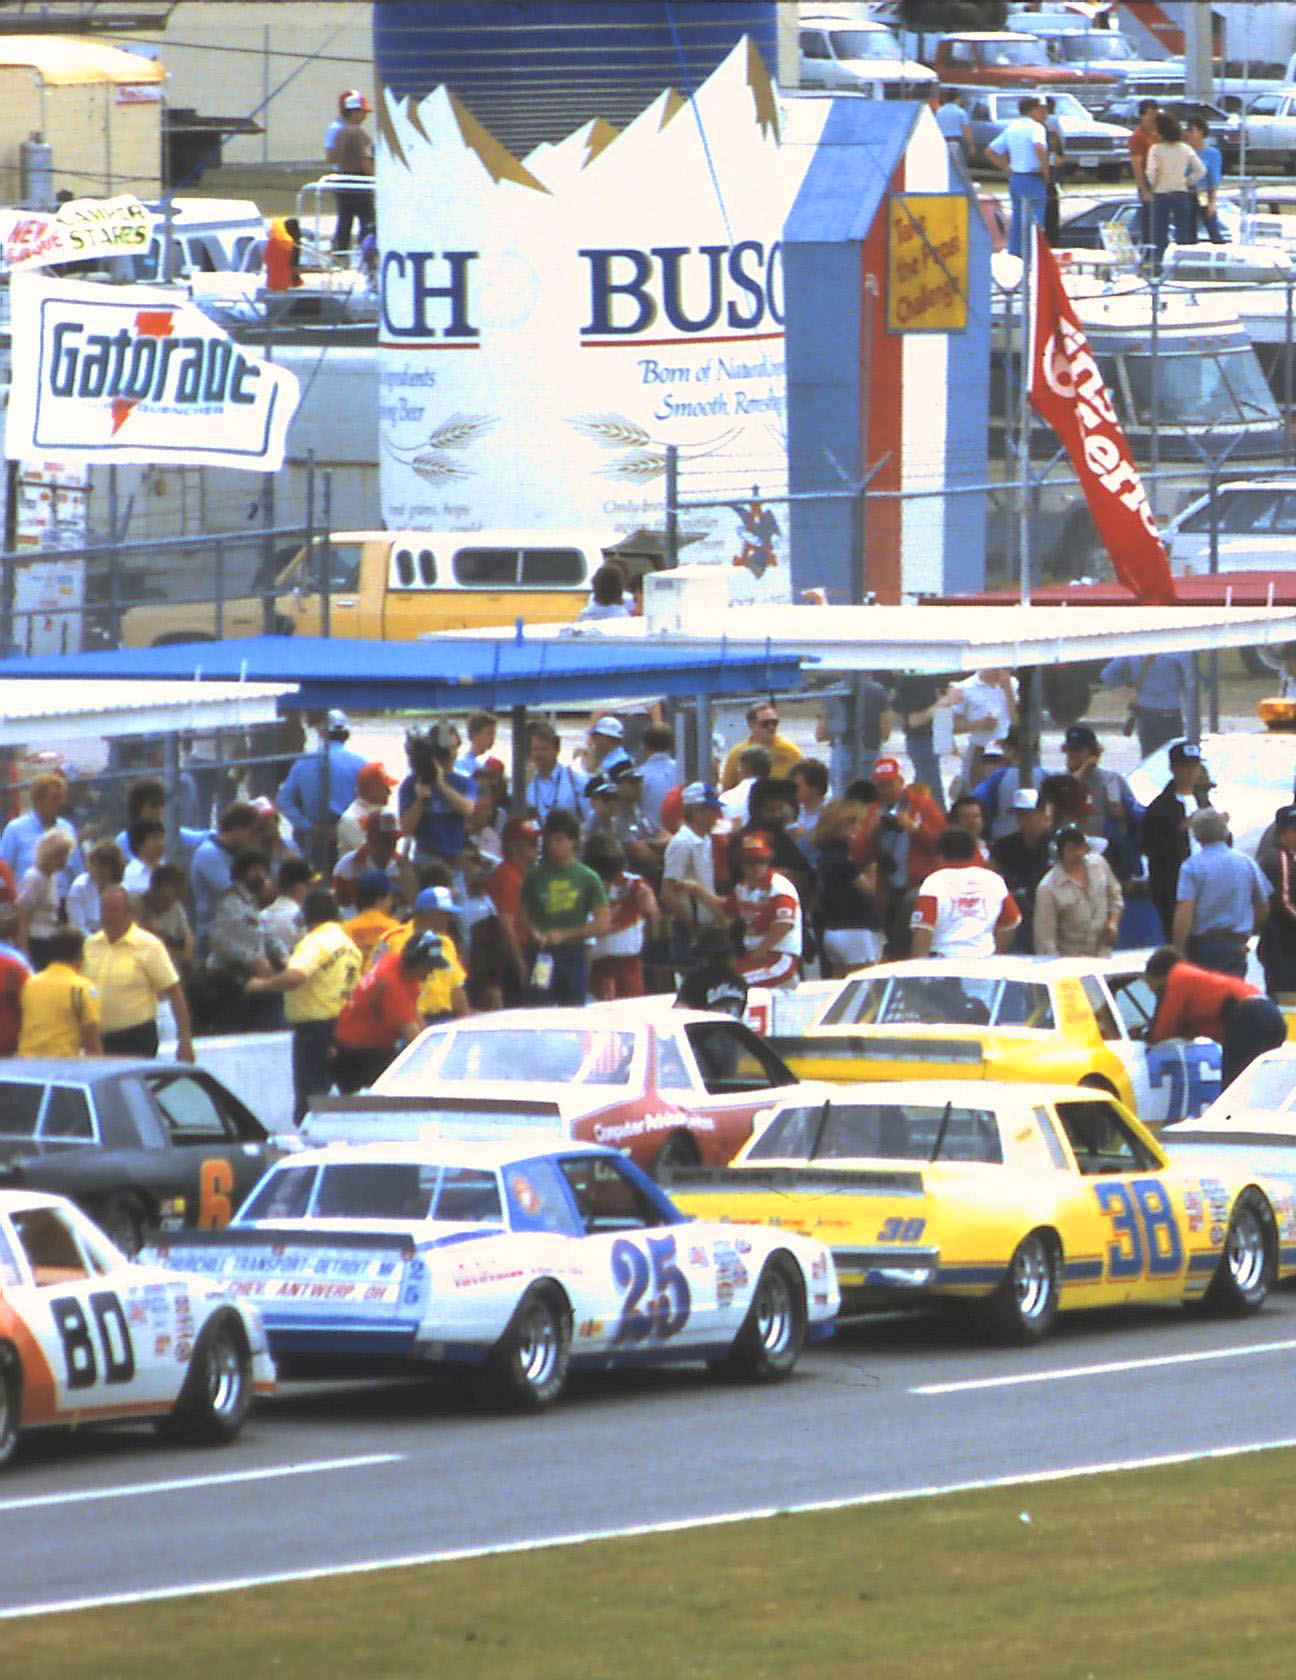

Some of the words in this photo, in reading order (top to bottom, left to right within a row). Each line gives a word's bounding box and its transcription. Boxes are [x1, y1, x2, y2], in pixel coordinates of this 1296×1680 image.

[877, 1217, 926, 1242] 38
[1094, 1179, 1183, 1279] 38
[49, 1290, 135, 1390] 80
[611, 1235, 690, 1345] 25
